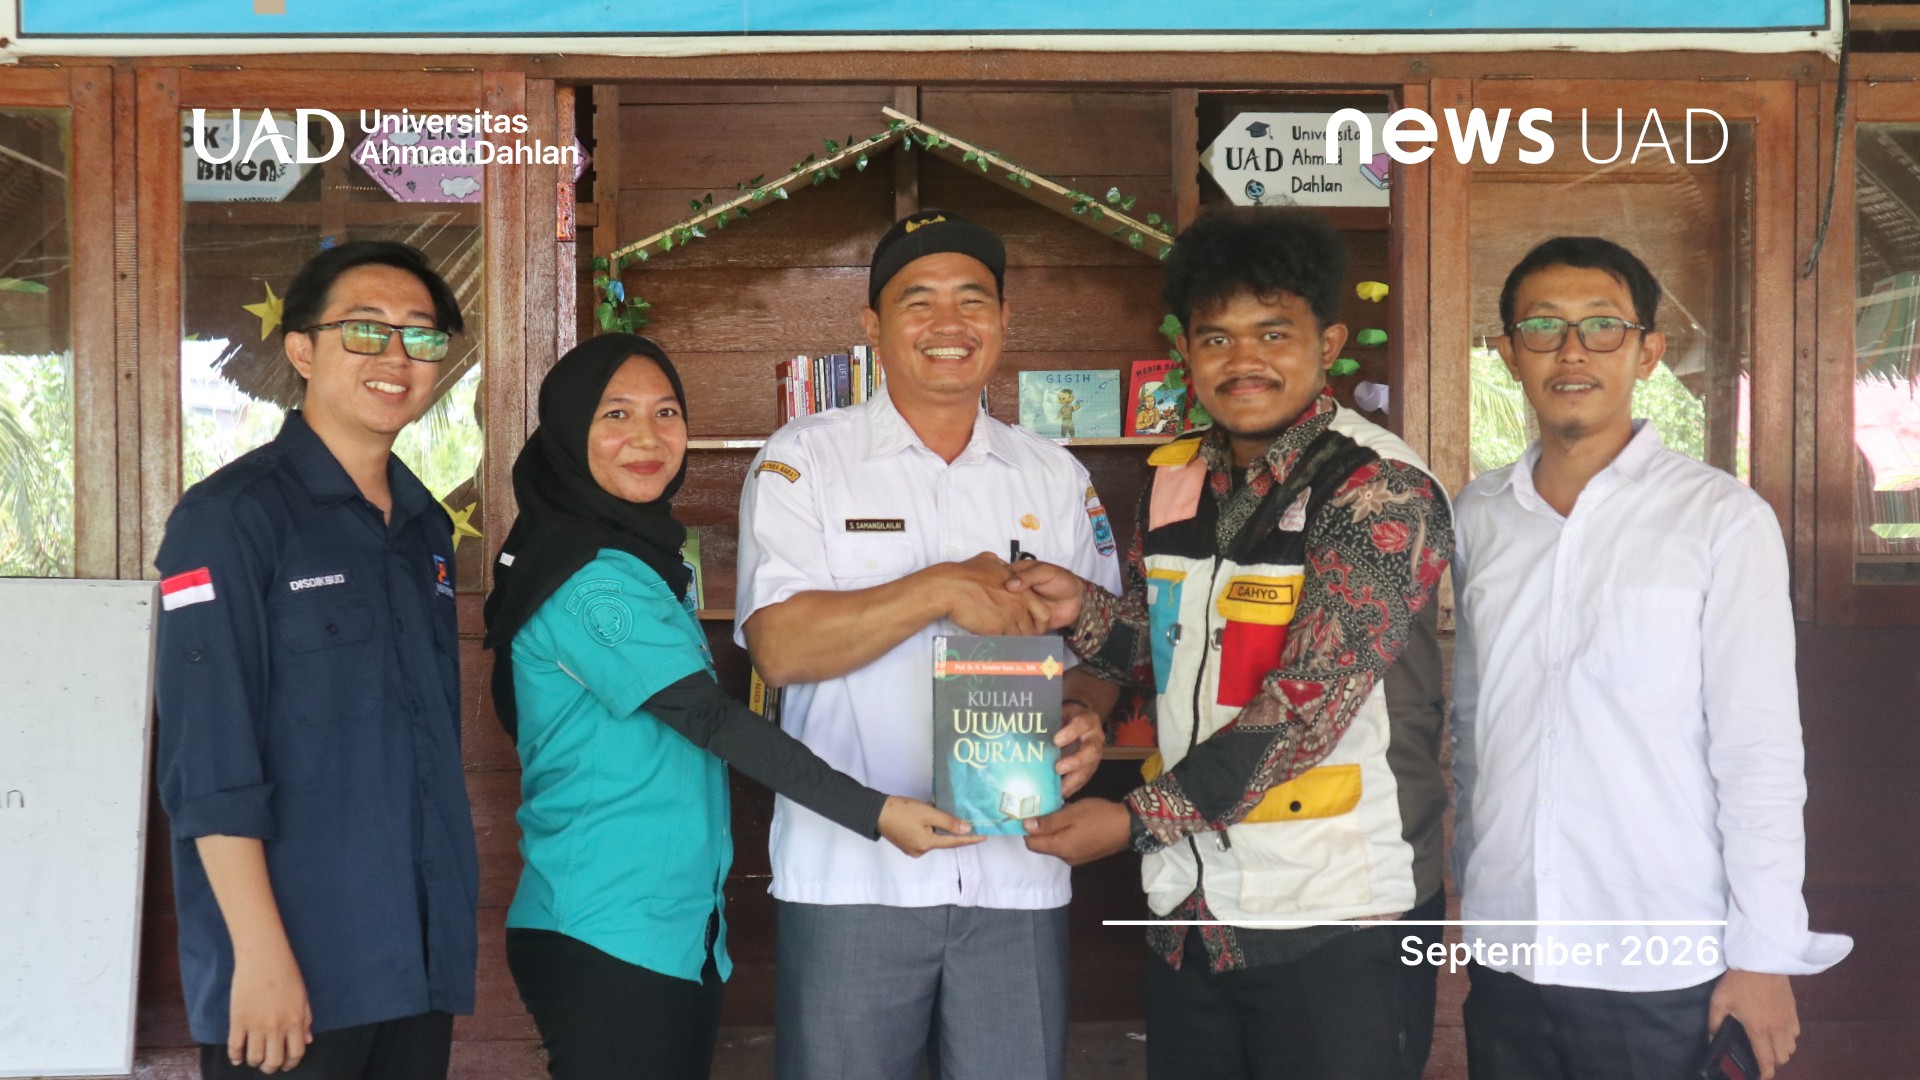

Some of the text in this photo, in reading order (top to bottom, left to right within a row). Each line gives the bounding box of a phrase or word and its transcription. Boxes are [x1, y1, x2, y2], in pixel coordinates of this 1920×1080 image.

[1225, 147, 1284, 172] UAD
[1292, 148, 1343, 166] Ahmd
[197, 158, 277, 182] BACA
[1291, 175, 1343, 193] Dahlan
[1046, 373, 1091, 383] GIGIH
[1237, 586, 1279, 600] CAHYO
[968, 692, 1033, 707] KULIAH
[952, 709, 1048, 740] ULUMUL
[953, 737, 1045, 769] QUR'AN
